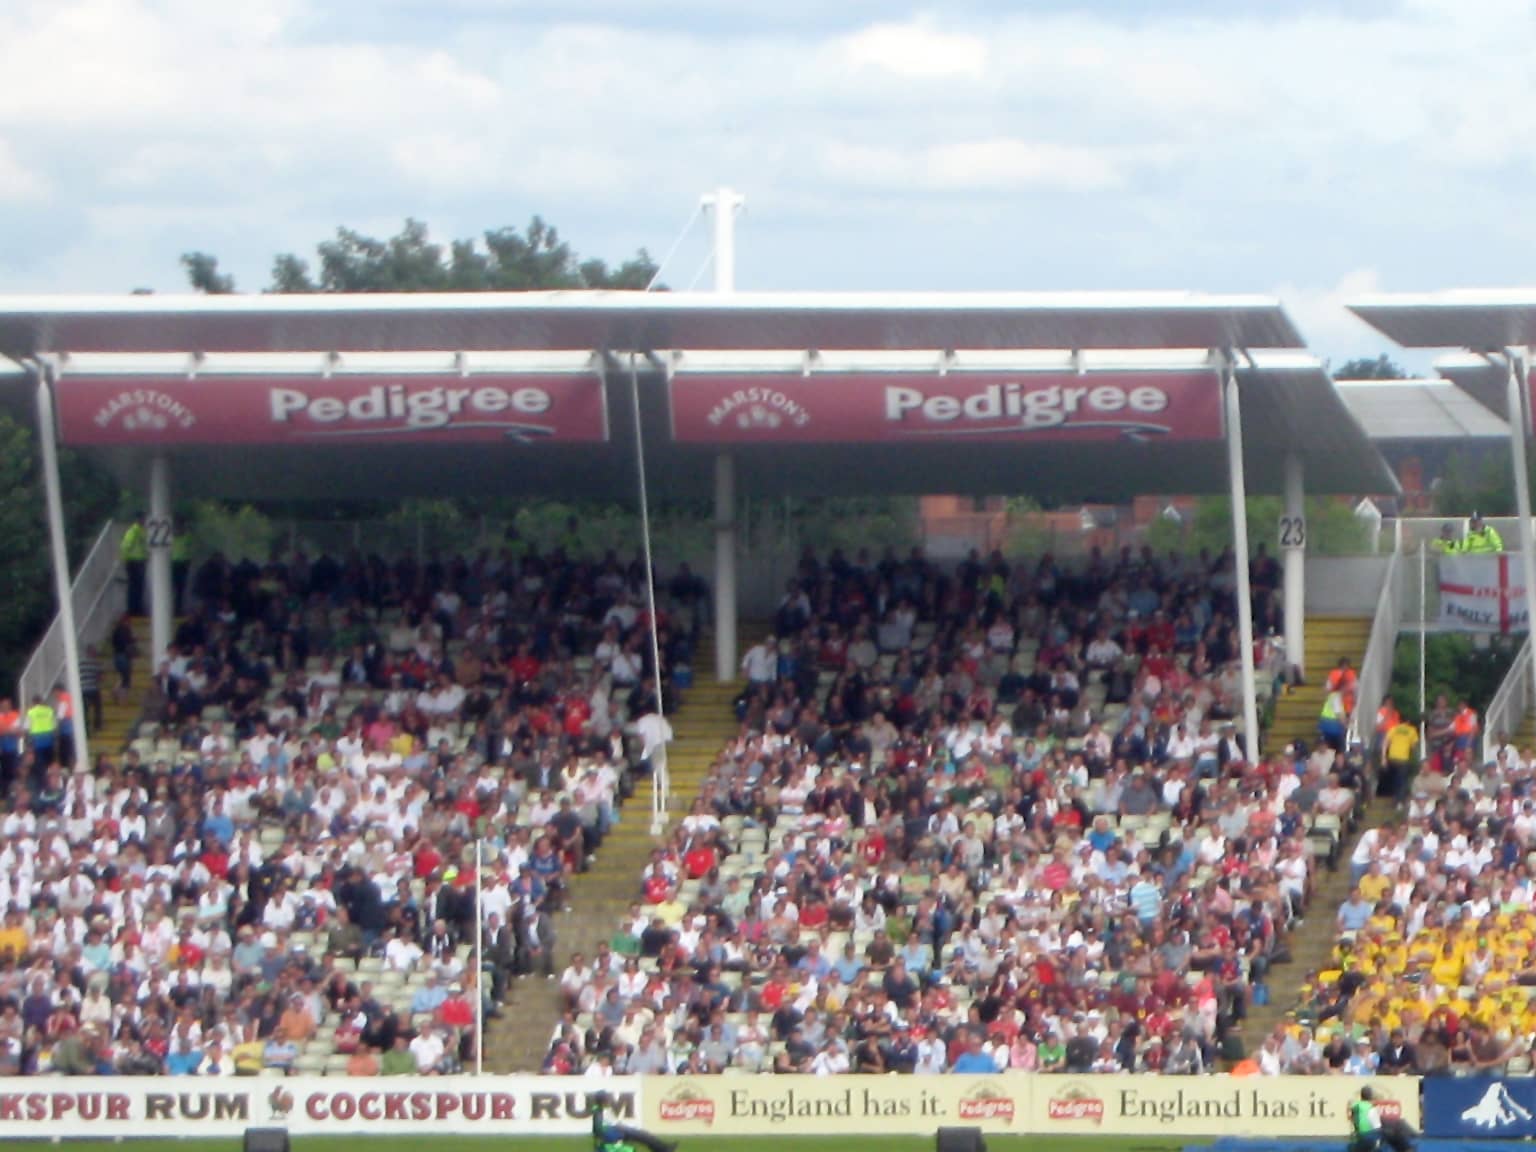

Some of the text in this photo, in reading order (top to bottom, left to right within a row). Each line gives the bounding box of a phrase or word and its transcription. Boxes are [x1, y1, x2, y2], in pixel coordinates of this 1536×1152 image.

[270, 384, 549, 428] Pedigree
[884, 383, 1168, 428] Pedigree
[1280, 517, 1304, 547] 23
[145, 1093, 249, 1120] RUM
[305, 1091, 635, 1121] COCKSPUR RUM
[730, 1088, 947, 1123] England has it.
[1119, 1089, 1241, 1123] England
[1252, 1089, 1299, 1118] has
[1309, 1091, 1335, 1118] it.
